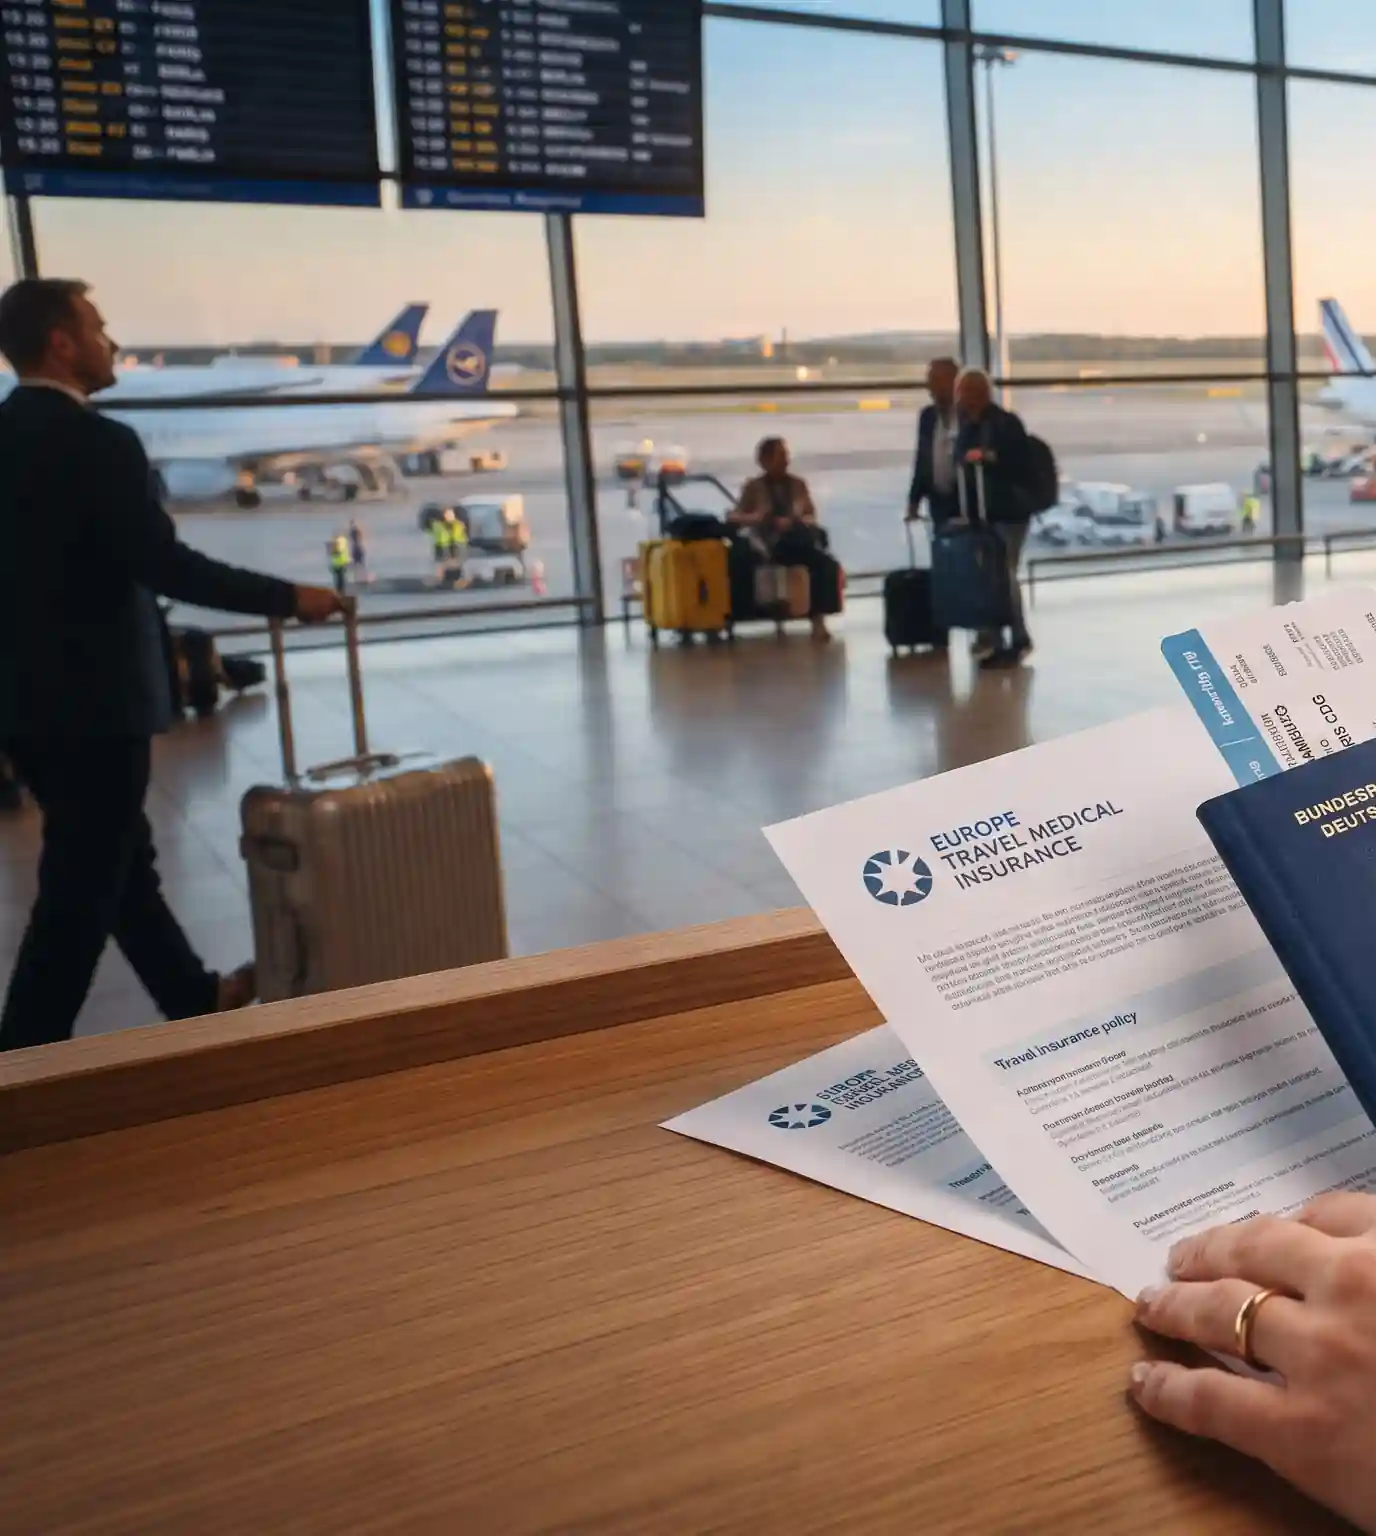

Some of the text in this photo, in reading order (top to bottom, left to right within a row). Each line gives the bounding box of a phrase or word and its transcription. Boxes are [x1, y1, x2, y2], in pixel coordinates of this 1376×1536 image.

[1312, 694, 1338, 725] CDG
[930, 810, 1021, 852] EUROPE
[941, 800, 1124, 871] TRAVEL MEDICAL
[954, 835, 1083, 891] INSURANCE
[1102, 1010, 1139, 1035] policy
